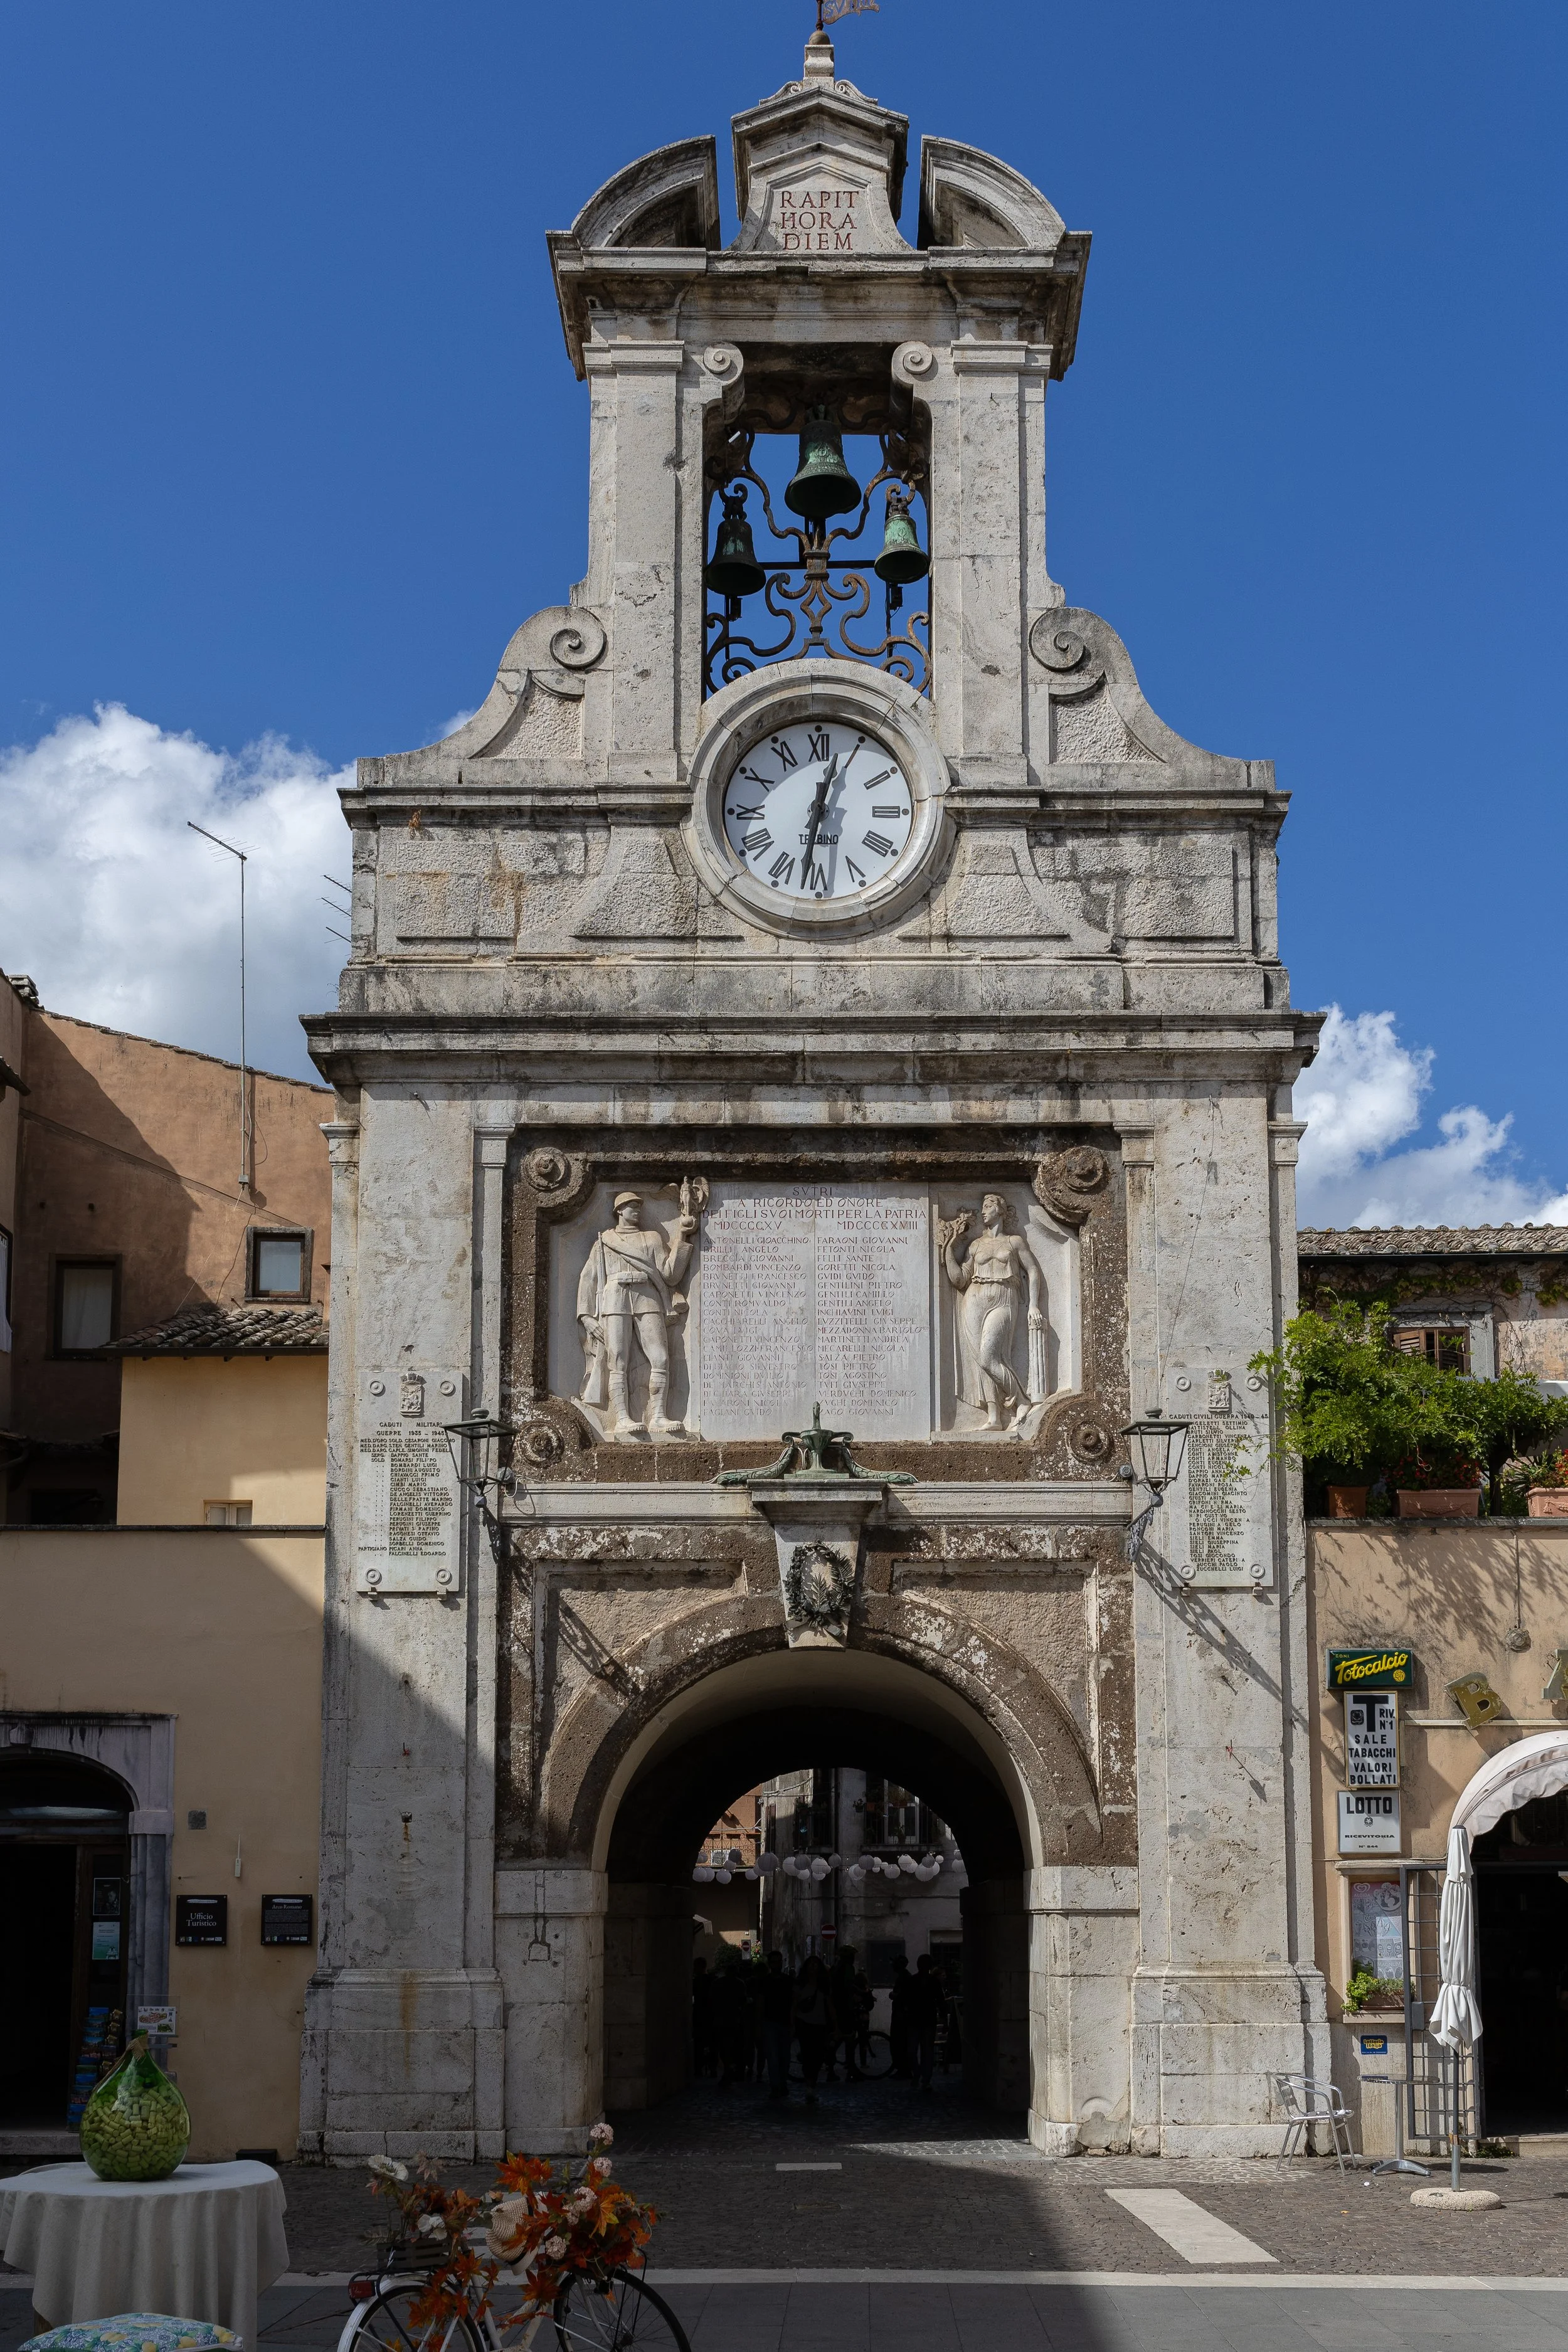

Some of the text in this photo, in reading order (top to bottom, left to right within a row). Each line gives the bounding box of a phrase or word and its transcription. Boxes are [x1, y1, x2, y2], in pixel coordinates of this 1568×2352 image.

[780, 191, 859, 208] RAPIT
[780, 212, 857, 229] HORA
[783, 233, 853, 250] DIEM
[744, 768, 775, 792] X
[798, 834, 839, 844] TRBINO
[817, 1199, 833, 1207] ED
[838, 1199, 883, 1207] ONORE
[702, 1210, 721, 1218] DEI
[726, 1210, 756, 1218] FIGLI
[795, 1210, 834, 1218] MORTI
[838, 1210, 862, 1218] PER
[866, 1210, 881, 1218] LA
[885, 1210, 926, 1218] PATRIA
[1335, 1652, 1407, 1684] Totocalcio
[1353, 1695, 1389, 1732] T
[1379, 1708, 1395, 1719] RIV.
[1355, 1734, 1387, 1744] SALE
[1349, 1748, 1396, 1758] TABACCHI
[1353, 1762, 1392, 1772] VALORI
[1350, 1774, 1396, 1784] BOLLATI
[1347, 1797, 1392, 1814] LOTTO
